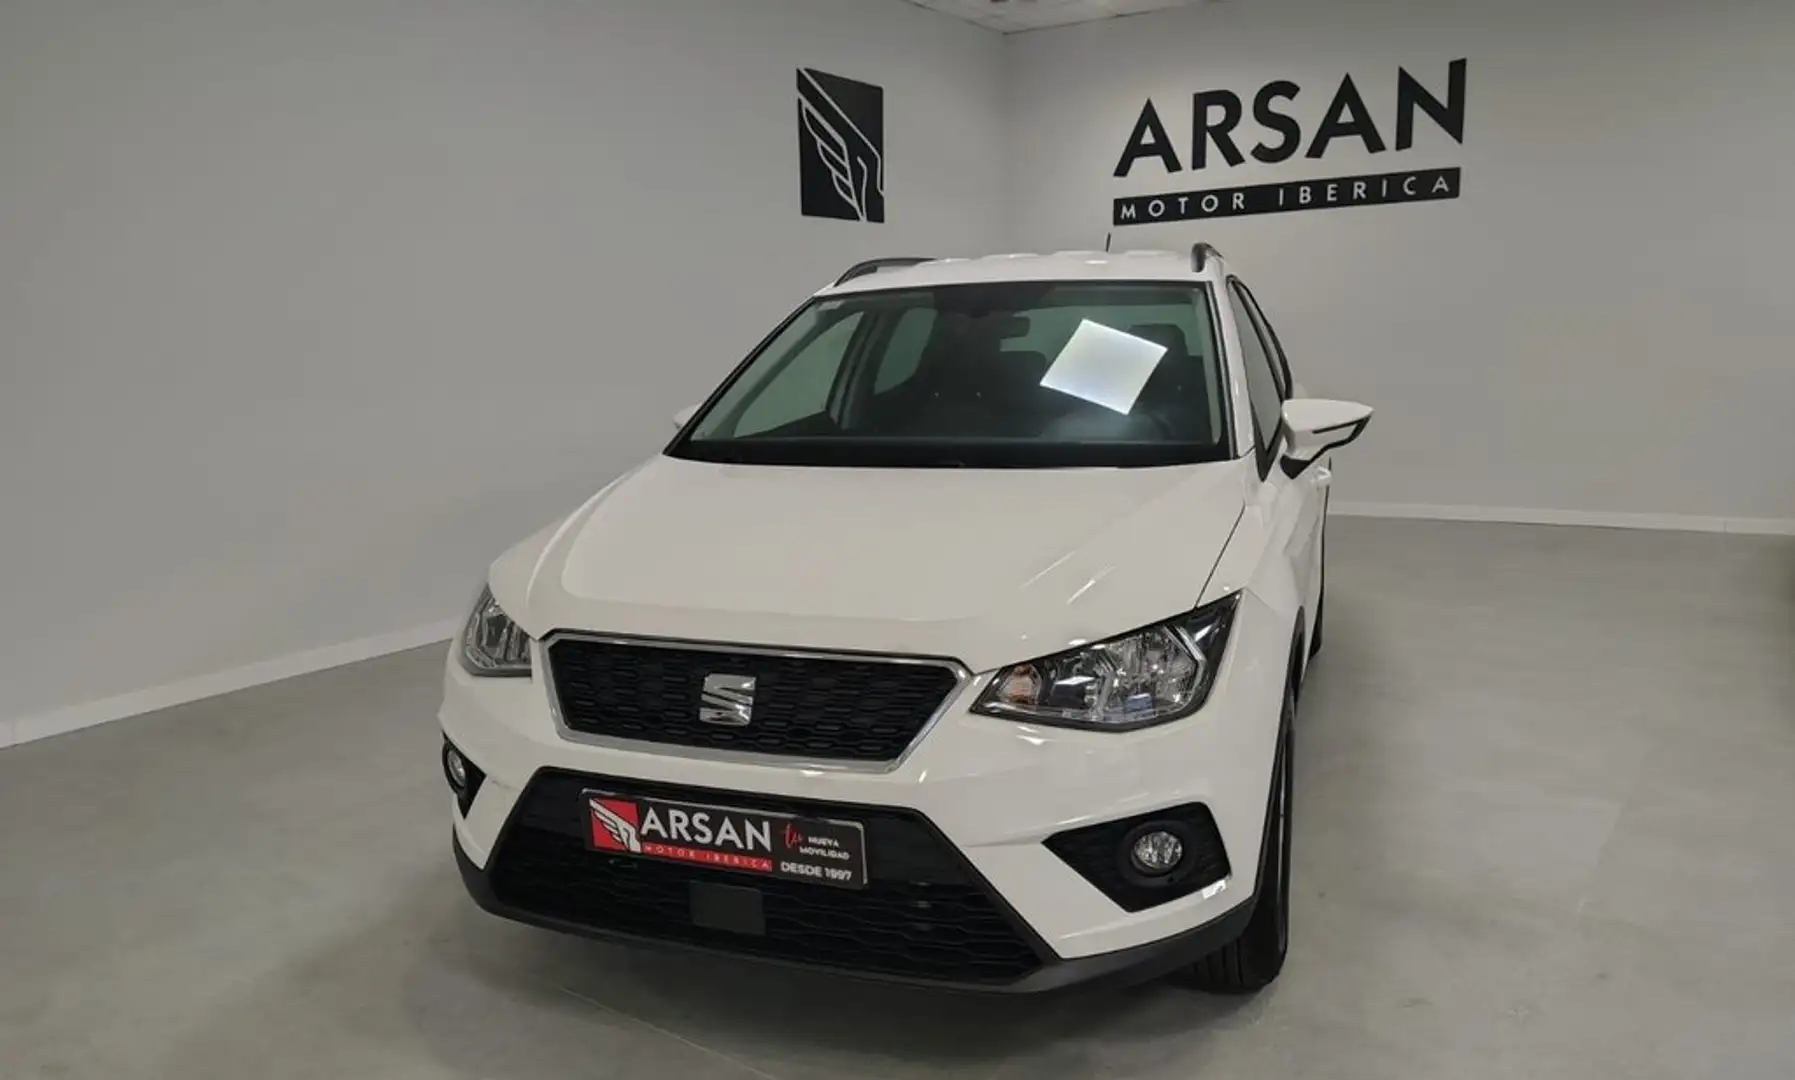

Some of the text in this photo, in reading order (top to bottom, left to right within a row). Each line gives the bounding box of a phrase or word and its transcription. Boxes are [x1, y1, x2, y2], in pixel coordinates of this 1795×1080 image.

[1113, 58, 1467, 177] ARSAN
[1120, 175, 1449, 220] MOTOR IBERICA
[640, 806, 772, 852] ARSAN
[643, 845, 695, 858] MOTOR
[799, 845, 850, 860] MOVILIDAD
[780, 861, 852, 881] DESDE 1997
